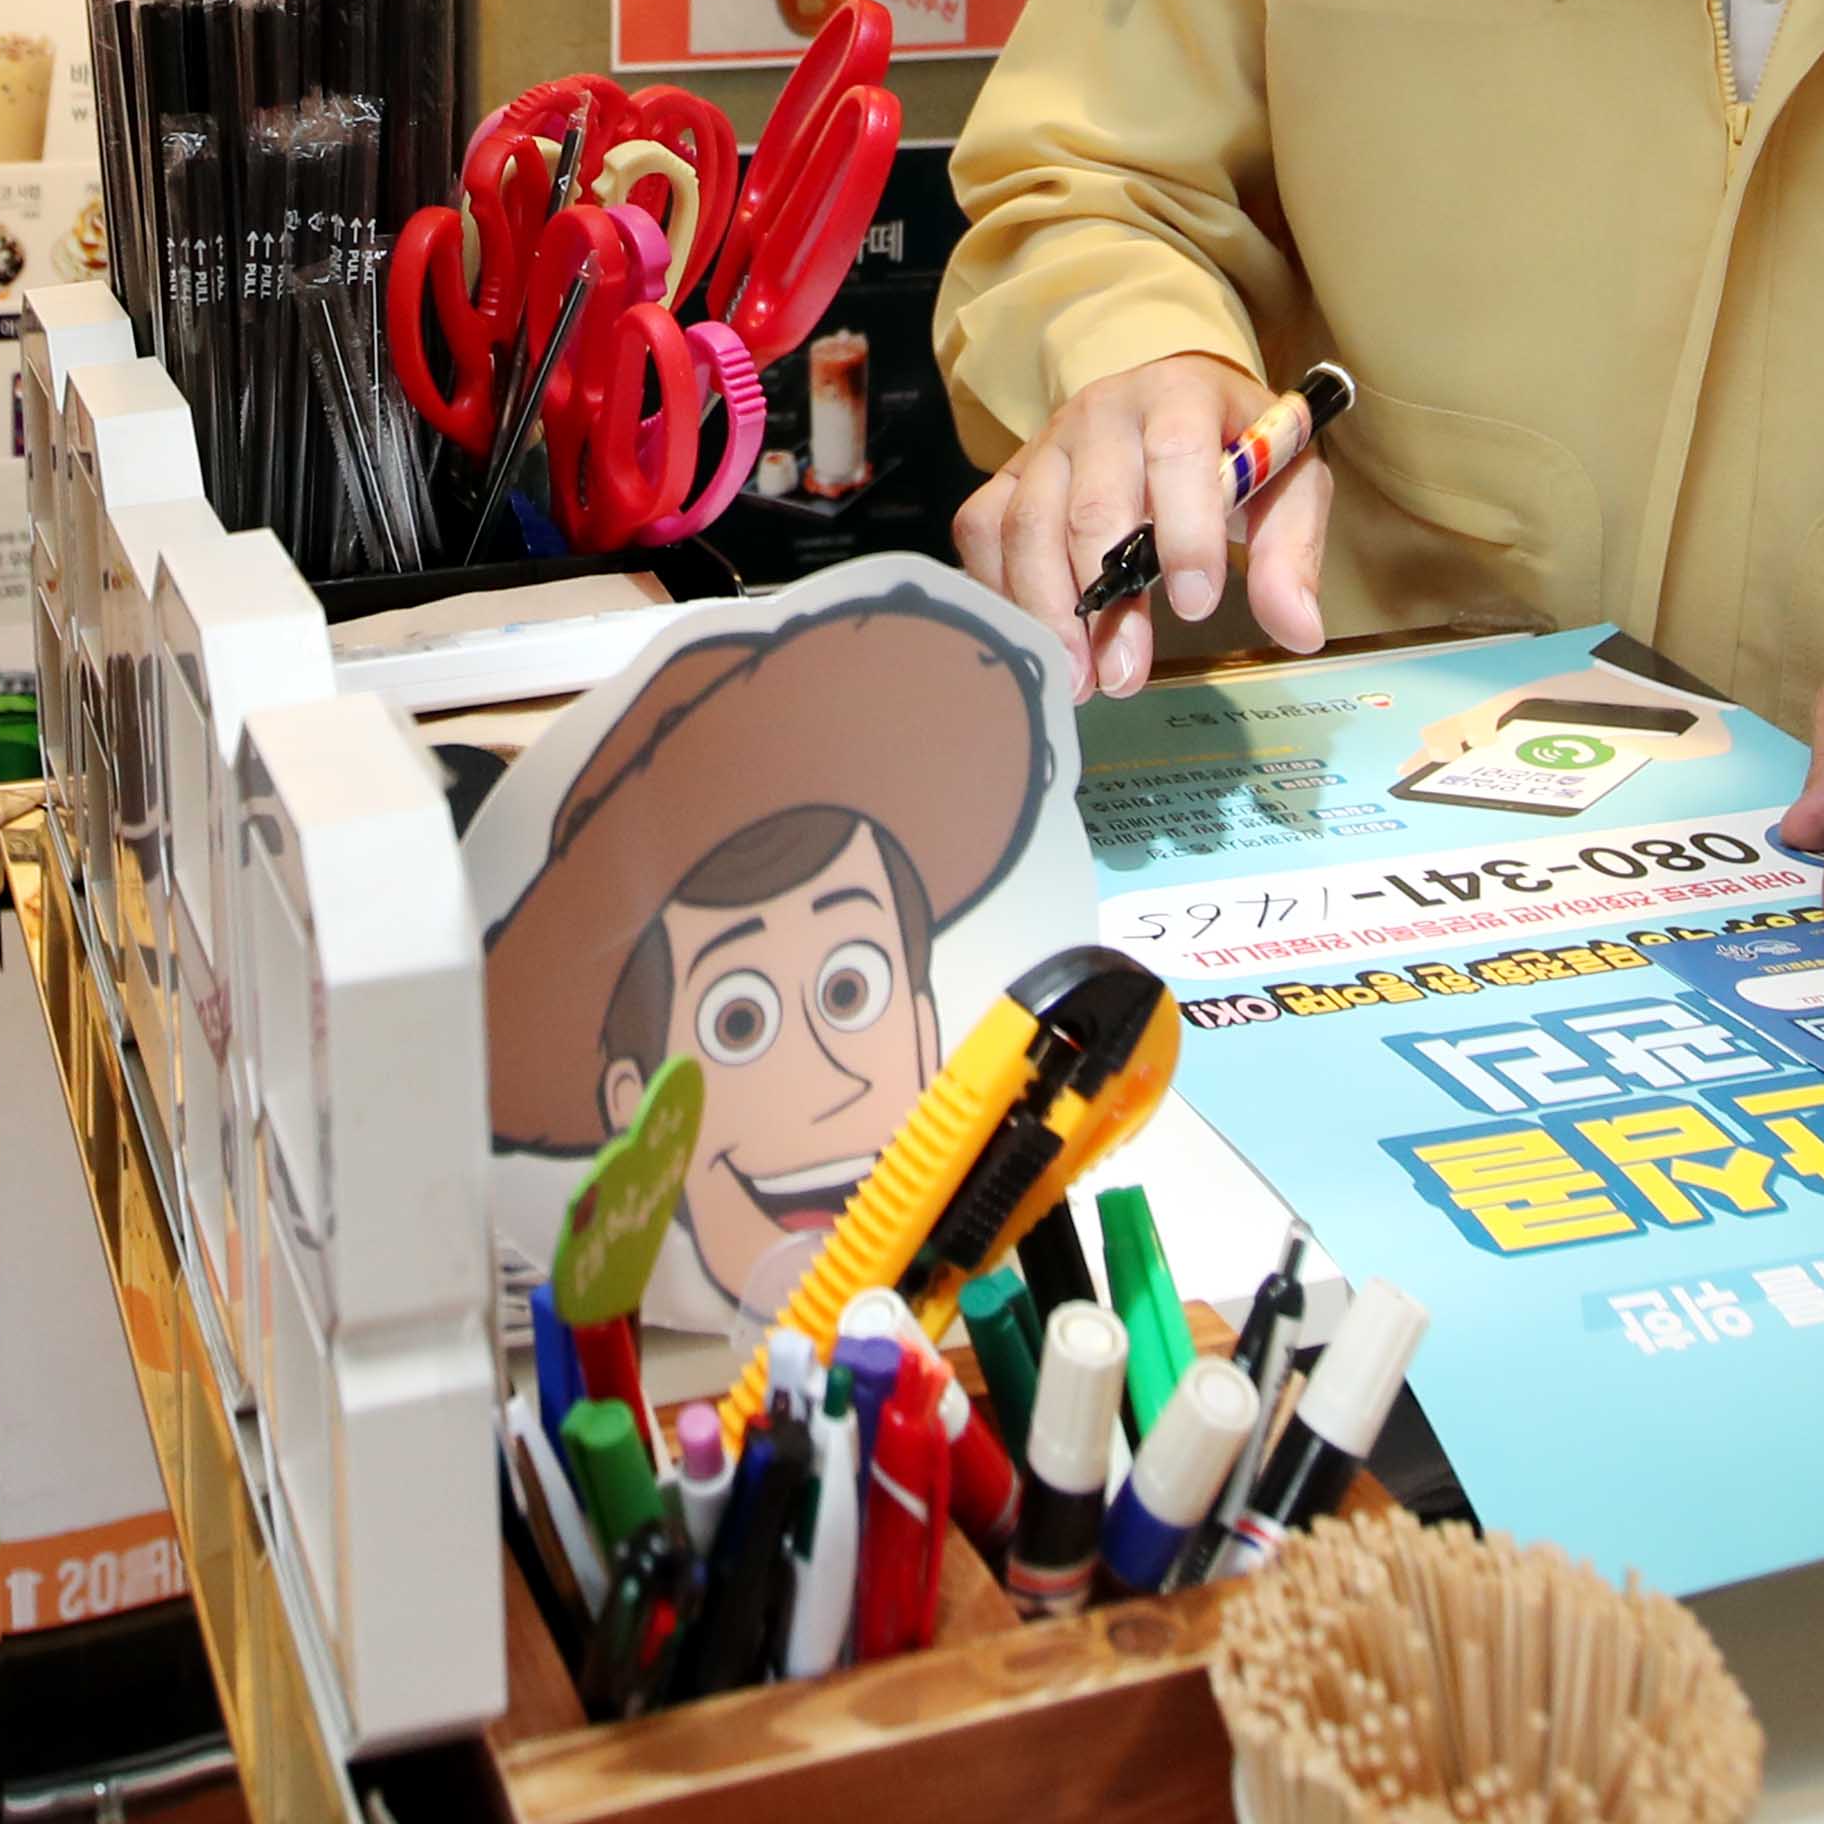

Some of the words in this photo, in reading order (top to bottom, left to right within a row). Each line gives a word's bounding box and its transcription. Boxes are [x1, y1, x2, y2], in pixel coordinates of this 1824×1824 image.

[244, 263, 257, 298] PULL
[260, 264, 272, 299] PULL
[347, 250, 359, 285] PULL
[195, 271, 208, 306] PULL
[1165, 711, 1219, 729] 동구
[1225, 697, 1357, 724] 인천광역시
[1217, 829, 1325, 852] 인천광역시
[1658, 878, 1743, 901] 번호로
[1745, 871, 1806, 890] 아래
[1506, 890, 1657, 925] 전화하시면
[1352, 911, 1504, 946] 방문등록이
[1183, 933, 1351, 969] 완료됩니다.
[1478, 943, 1650, 985] 무료전화
[1416, 965, 1480, 995] 한
[1186, 997, 1281, 1029] OK!
[1605, 1288, 1753, 1355] 위한
